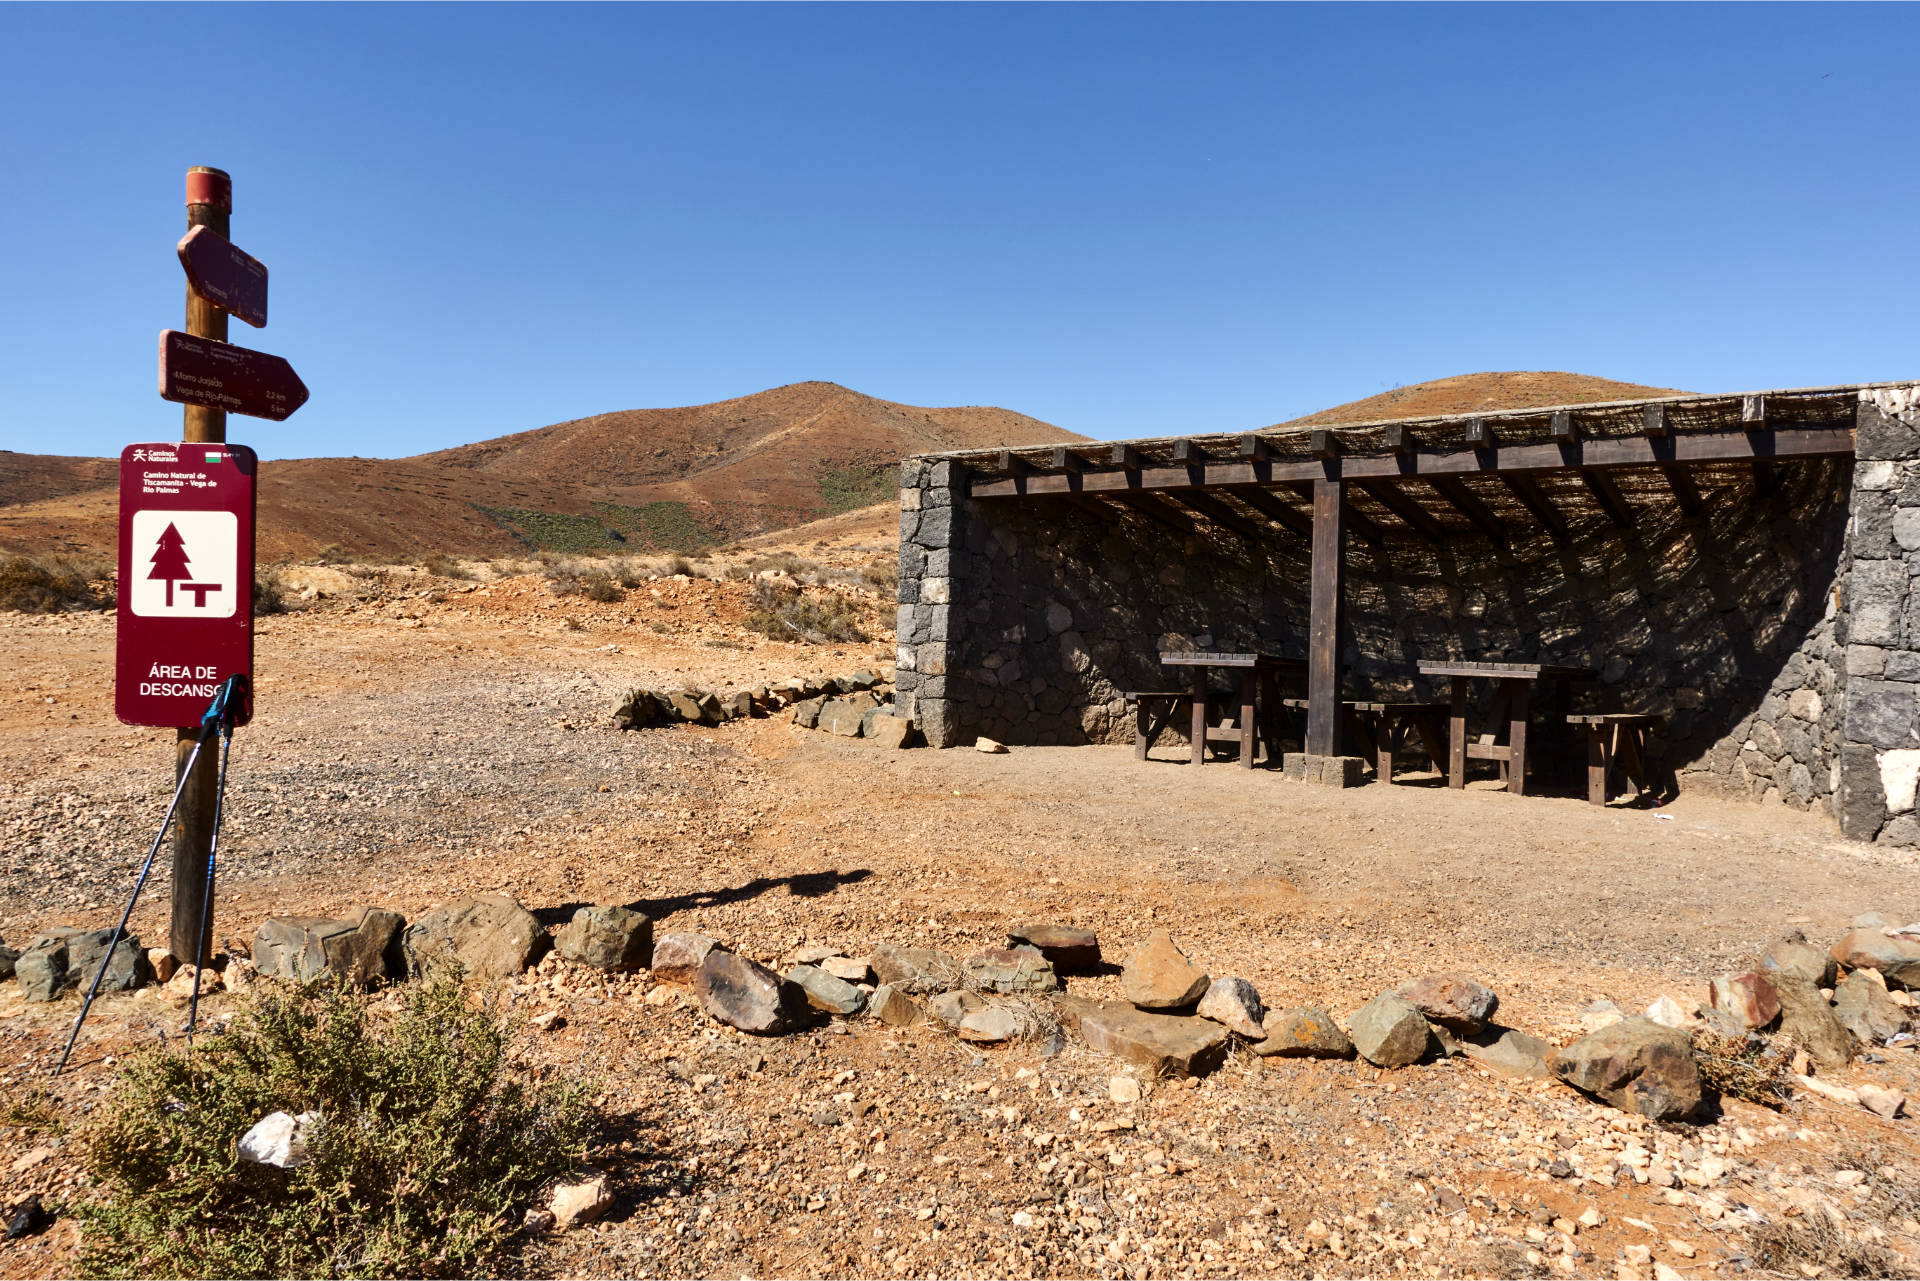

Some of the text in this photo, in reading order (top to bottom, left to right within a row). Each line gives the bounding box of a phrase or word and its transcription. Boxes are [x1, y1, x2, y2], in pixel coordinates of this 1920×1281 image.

[175, 370, 197, 382] Morro
[176, 385, 194, 397] Vega
[195, 389, 204, 398] de
[217, 393, 242, 405] Palmas
[276, 392, 286, 400] km
[271, 403, 286, 414] 5 km
[143, 471, 169, 479] Camino
[143, 478, 184, 486] Tiscamanita
[190, 479, 206, 488] Vega
[155, 486, 180, 494] Palmas
[149, 662, 217, 679] ÁREA DE
